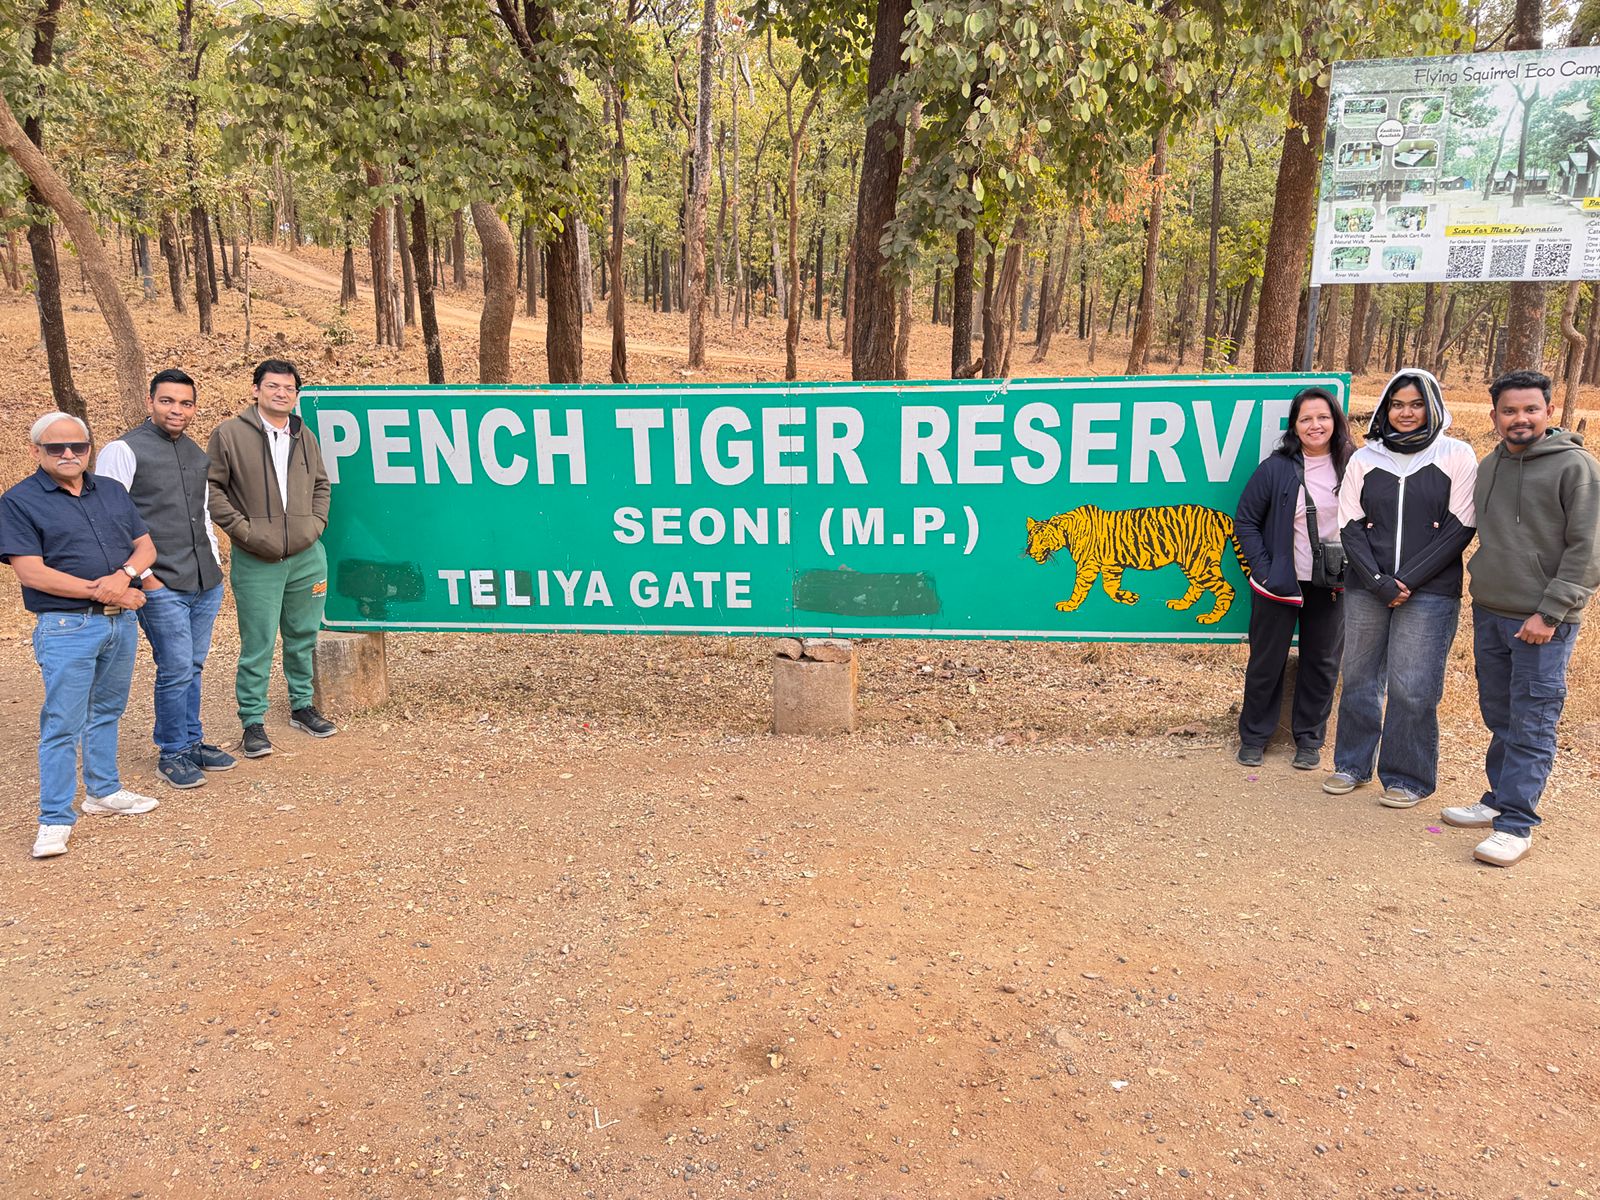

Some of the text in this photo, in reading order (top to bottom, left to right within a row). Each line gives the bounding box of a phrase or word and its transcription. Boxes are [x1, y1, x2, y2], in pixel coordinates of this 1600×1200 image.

[1414, 68, 1458, 86] Flying
[1463, 64, 1520, 84] Squirrel
[1525, 63, 1555, 79] Eco
[1513, 225, 1563, 234] Information
[316, 407, 587, 485] PENCH
[615, 407, 868, 485] TIGER
[613, 506, 980, 556] SEONI (M.P.)
[438, 569, 752, 608] TELIYA GATE
